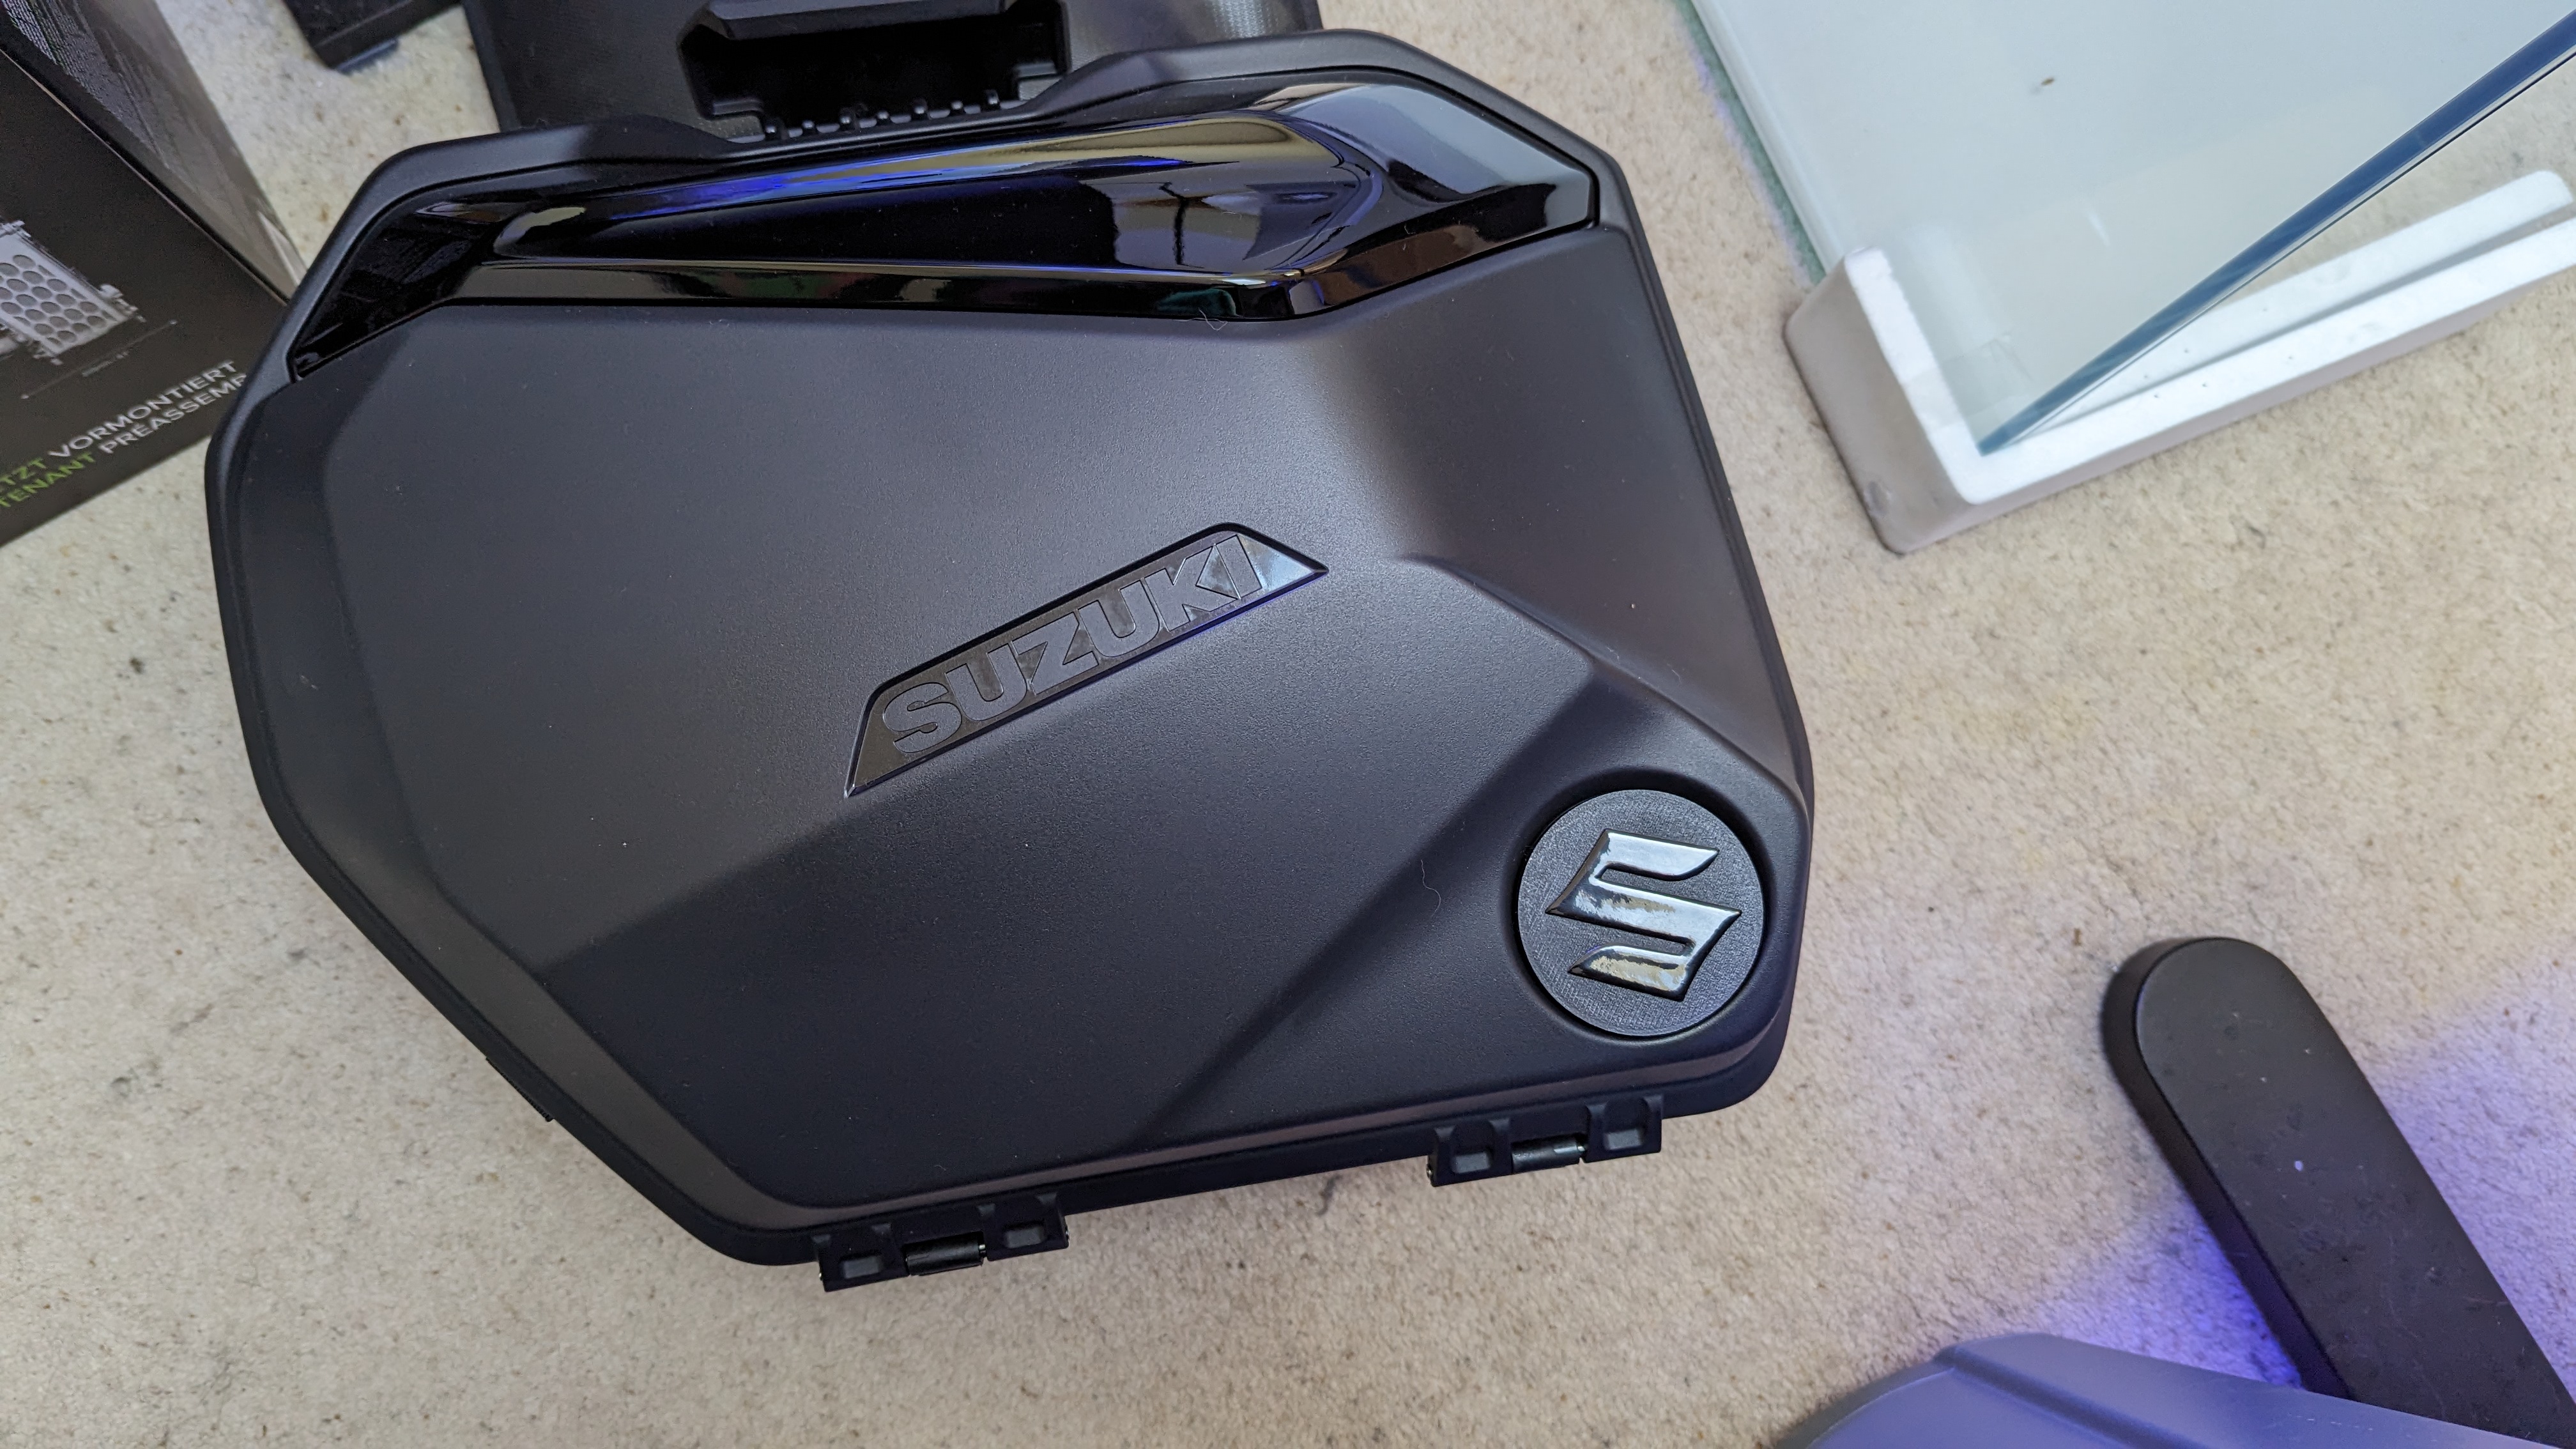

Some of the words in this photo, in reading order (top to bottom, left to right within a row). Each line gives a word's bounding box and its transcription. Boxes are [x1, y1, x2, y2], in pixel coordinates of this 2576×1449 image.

[0, 457, 46, 490] TZT
[49, 360, 236, 457] VORMONTIERT
[883, 533, 1263, 753] SUZUKI
